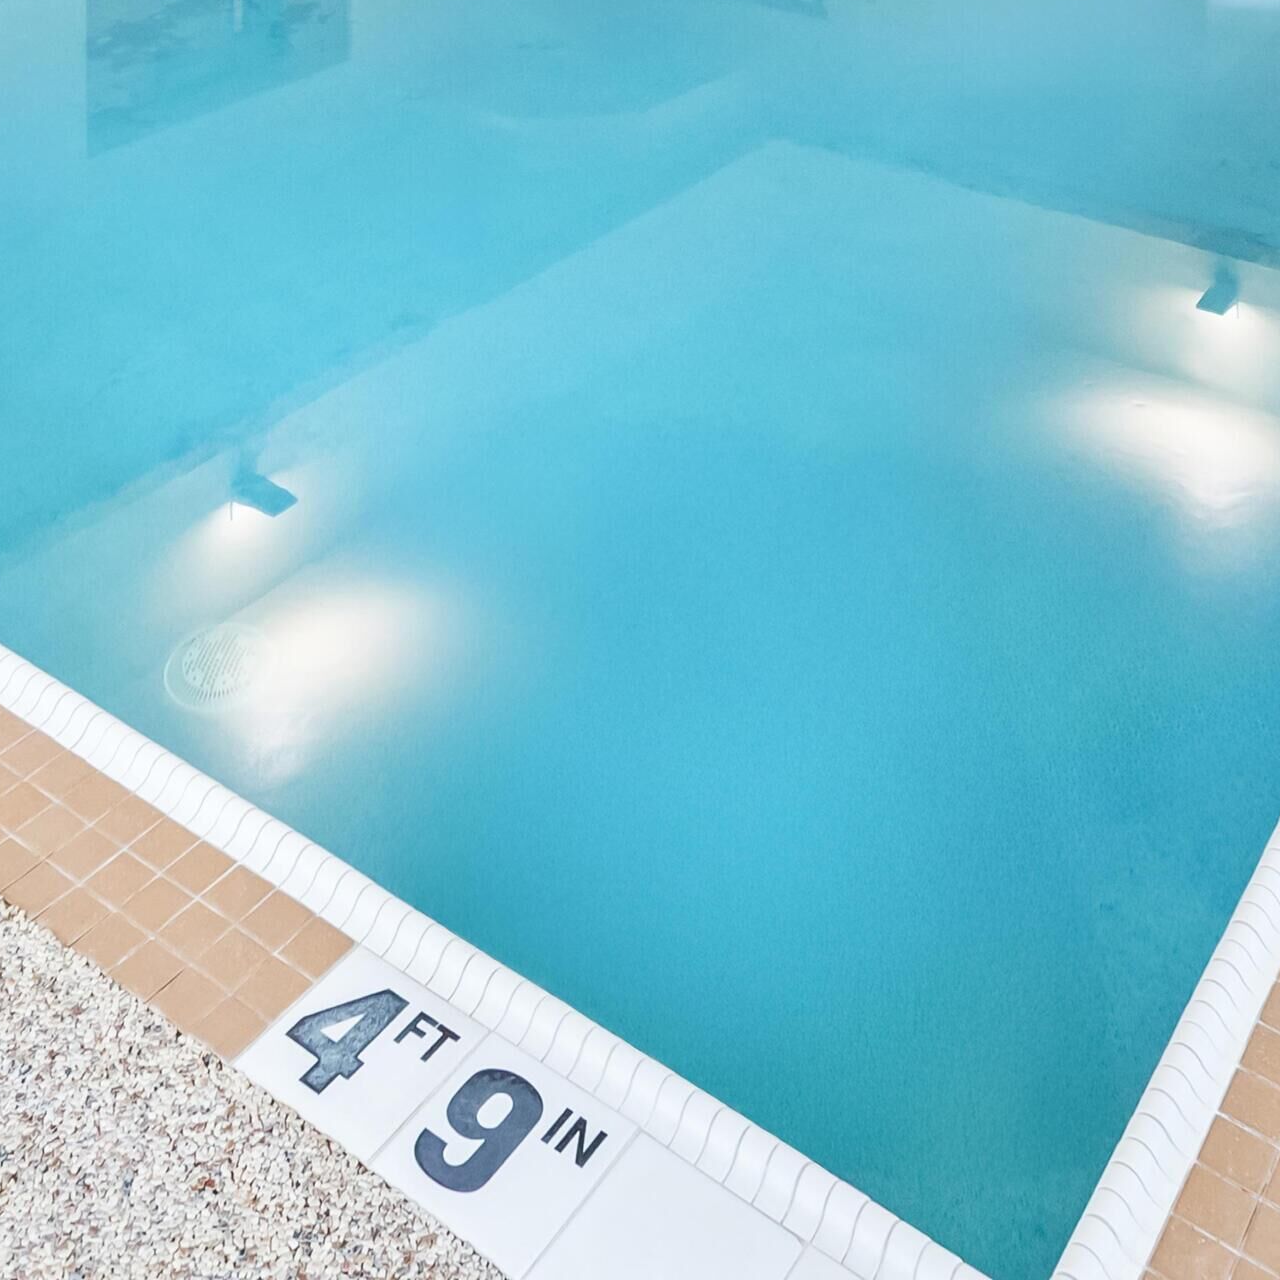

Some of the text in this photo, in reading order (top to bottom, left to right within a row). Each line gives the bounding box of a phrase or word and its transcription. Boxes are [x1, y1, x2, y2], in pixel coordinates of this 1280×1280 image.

[285, 987, 609, 1193] 4 FT 9 IN
